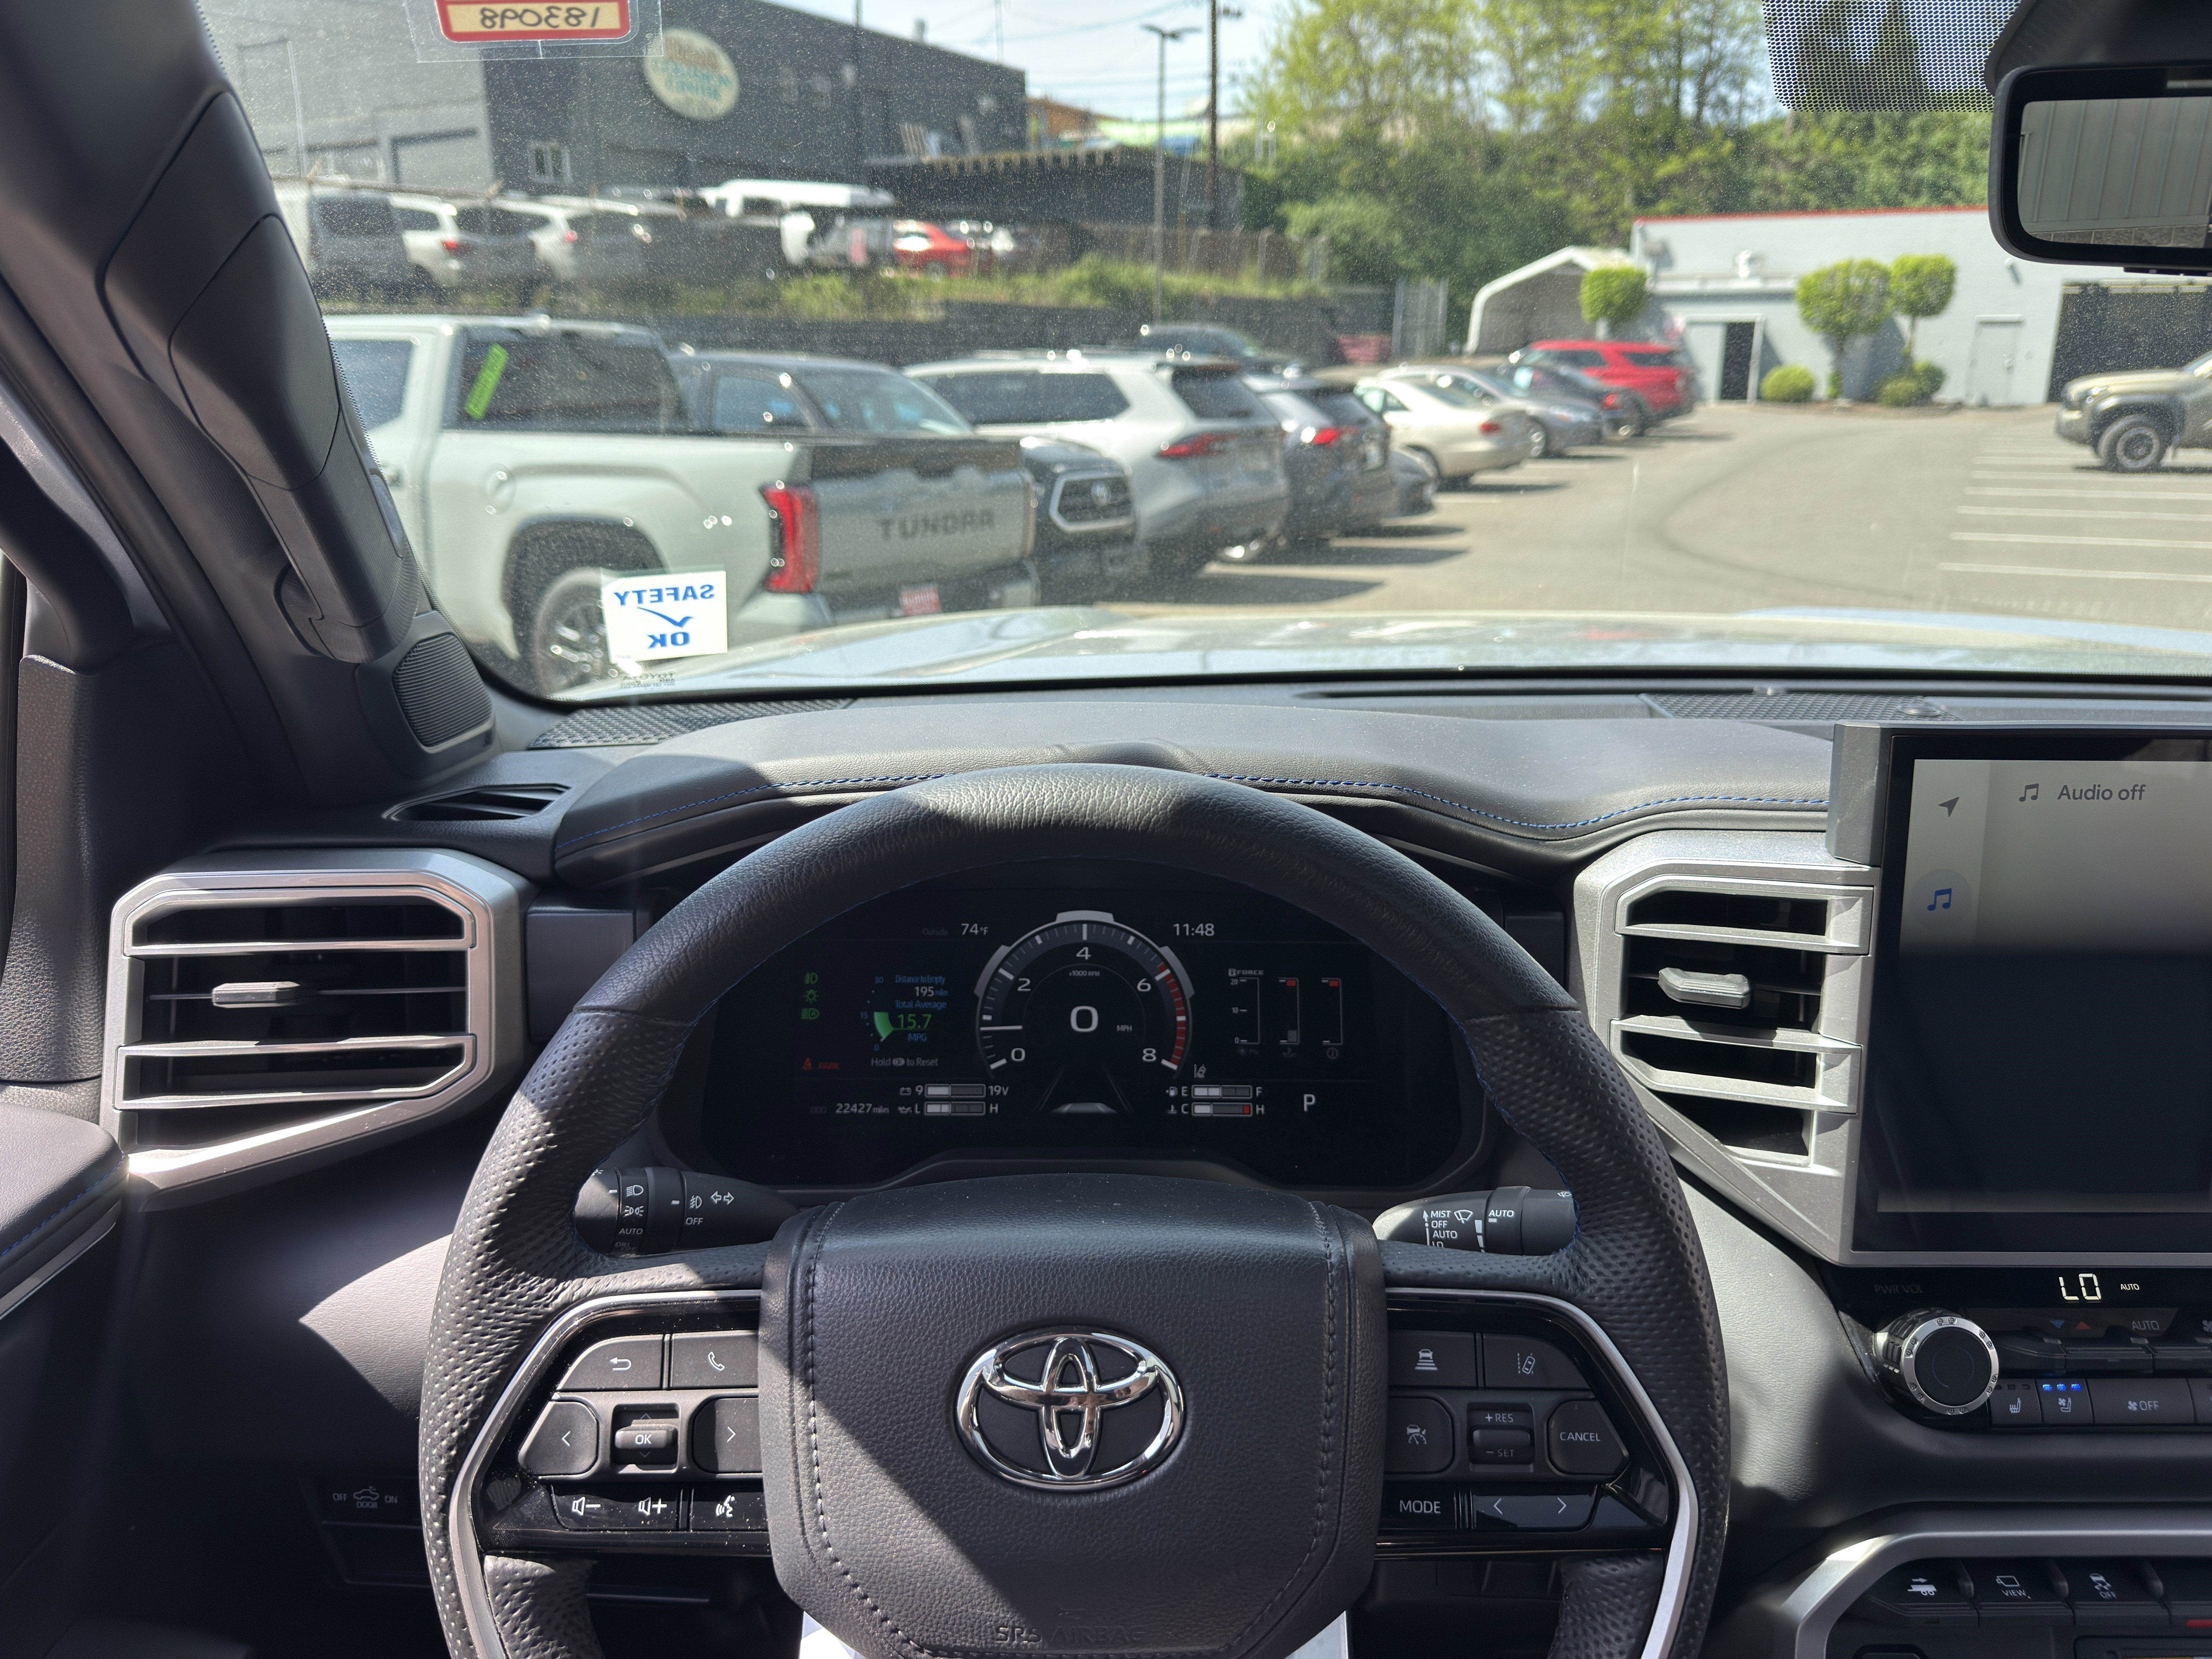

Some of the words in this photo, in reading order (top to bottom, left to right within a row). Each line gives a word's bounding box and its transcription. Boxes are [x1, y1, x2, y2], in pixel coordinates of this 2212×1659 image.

[878, 508, 995, 541] TUNDRA
[2057, 784, 2113, 801] Audio
[2118, 784, 2146, 801] off
[1173, 923, 1215, 936] 11:48
[1076, 946, 1092, 960] 4
[1017, 978, 1031, 992] 2
[1136, 978, 1152, 992] 6
[914, 986, 934, 997] 195
[894, 1000, 913, 1008] Total
[915, 1000, 948, 1010] Average
[897, 1013, 932, 1029] 15.7
[1070, 1005, 1099, 1033] 0
[907, 1033, 928, 1042] MPG
[1010, 1048, 1026, 1062] 0
[1142, 1048, 1157, 1062] 8
[871, 1058, 891, 1066] Hold
[906, 1058, 915, 1066] to
[916, 1058, 939, 1066] Reset
[915, 1085, 924, 1096] 9
[1181, 1086, 1188, 1096] E
[1256, 1086, 1263, 1097] F
[835, 1103, 873, 1114] 22427
[914, 1103, 921, 1114] L
[990, 1103, 998, 1114] H
[1181, 1103, 1189, 1114] C
[1303, 1094, 1316, 1112] P
[1256, 1104, 1265, 1115] H
[1430, 1210, 1451, 1218] MIST
[685, 1217, 704, 1225] OFF
[1433, 1230, 1458, 1239] AUTO
[1874, 1283, 1899, 1294] PWR
[1902, 1284, 1924, 1294] VOL
[2120, 1283, 2140, 1291] AUTO
[2132, 1320, 2160, 1331] AUTO
[2139, 1400, 2160, 1411] OFF
[635, 1434, 652, 1445] OK
[1560, 1431, 1601, 1442] CANCEL
[333, 1493, 348, 1501] OFF
[384, 1495, 398, 1503] ON
[1399, 1500, 1441, 1514] MODE
[2001, 1589, 2026, 1598] VIEW
[2099, 1591, 2116, 1599] OFF
[996, 1626, 1042, 1643] SRS
